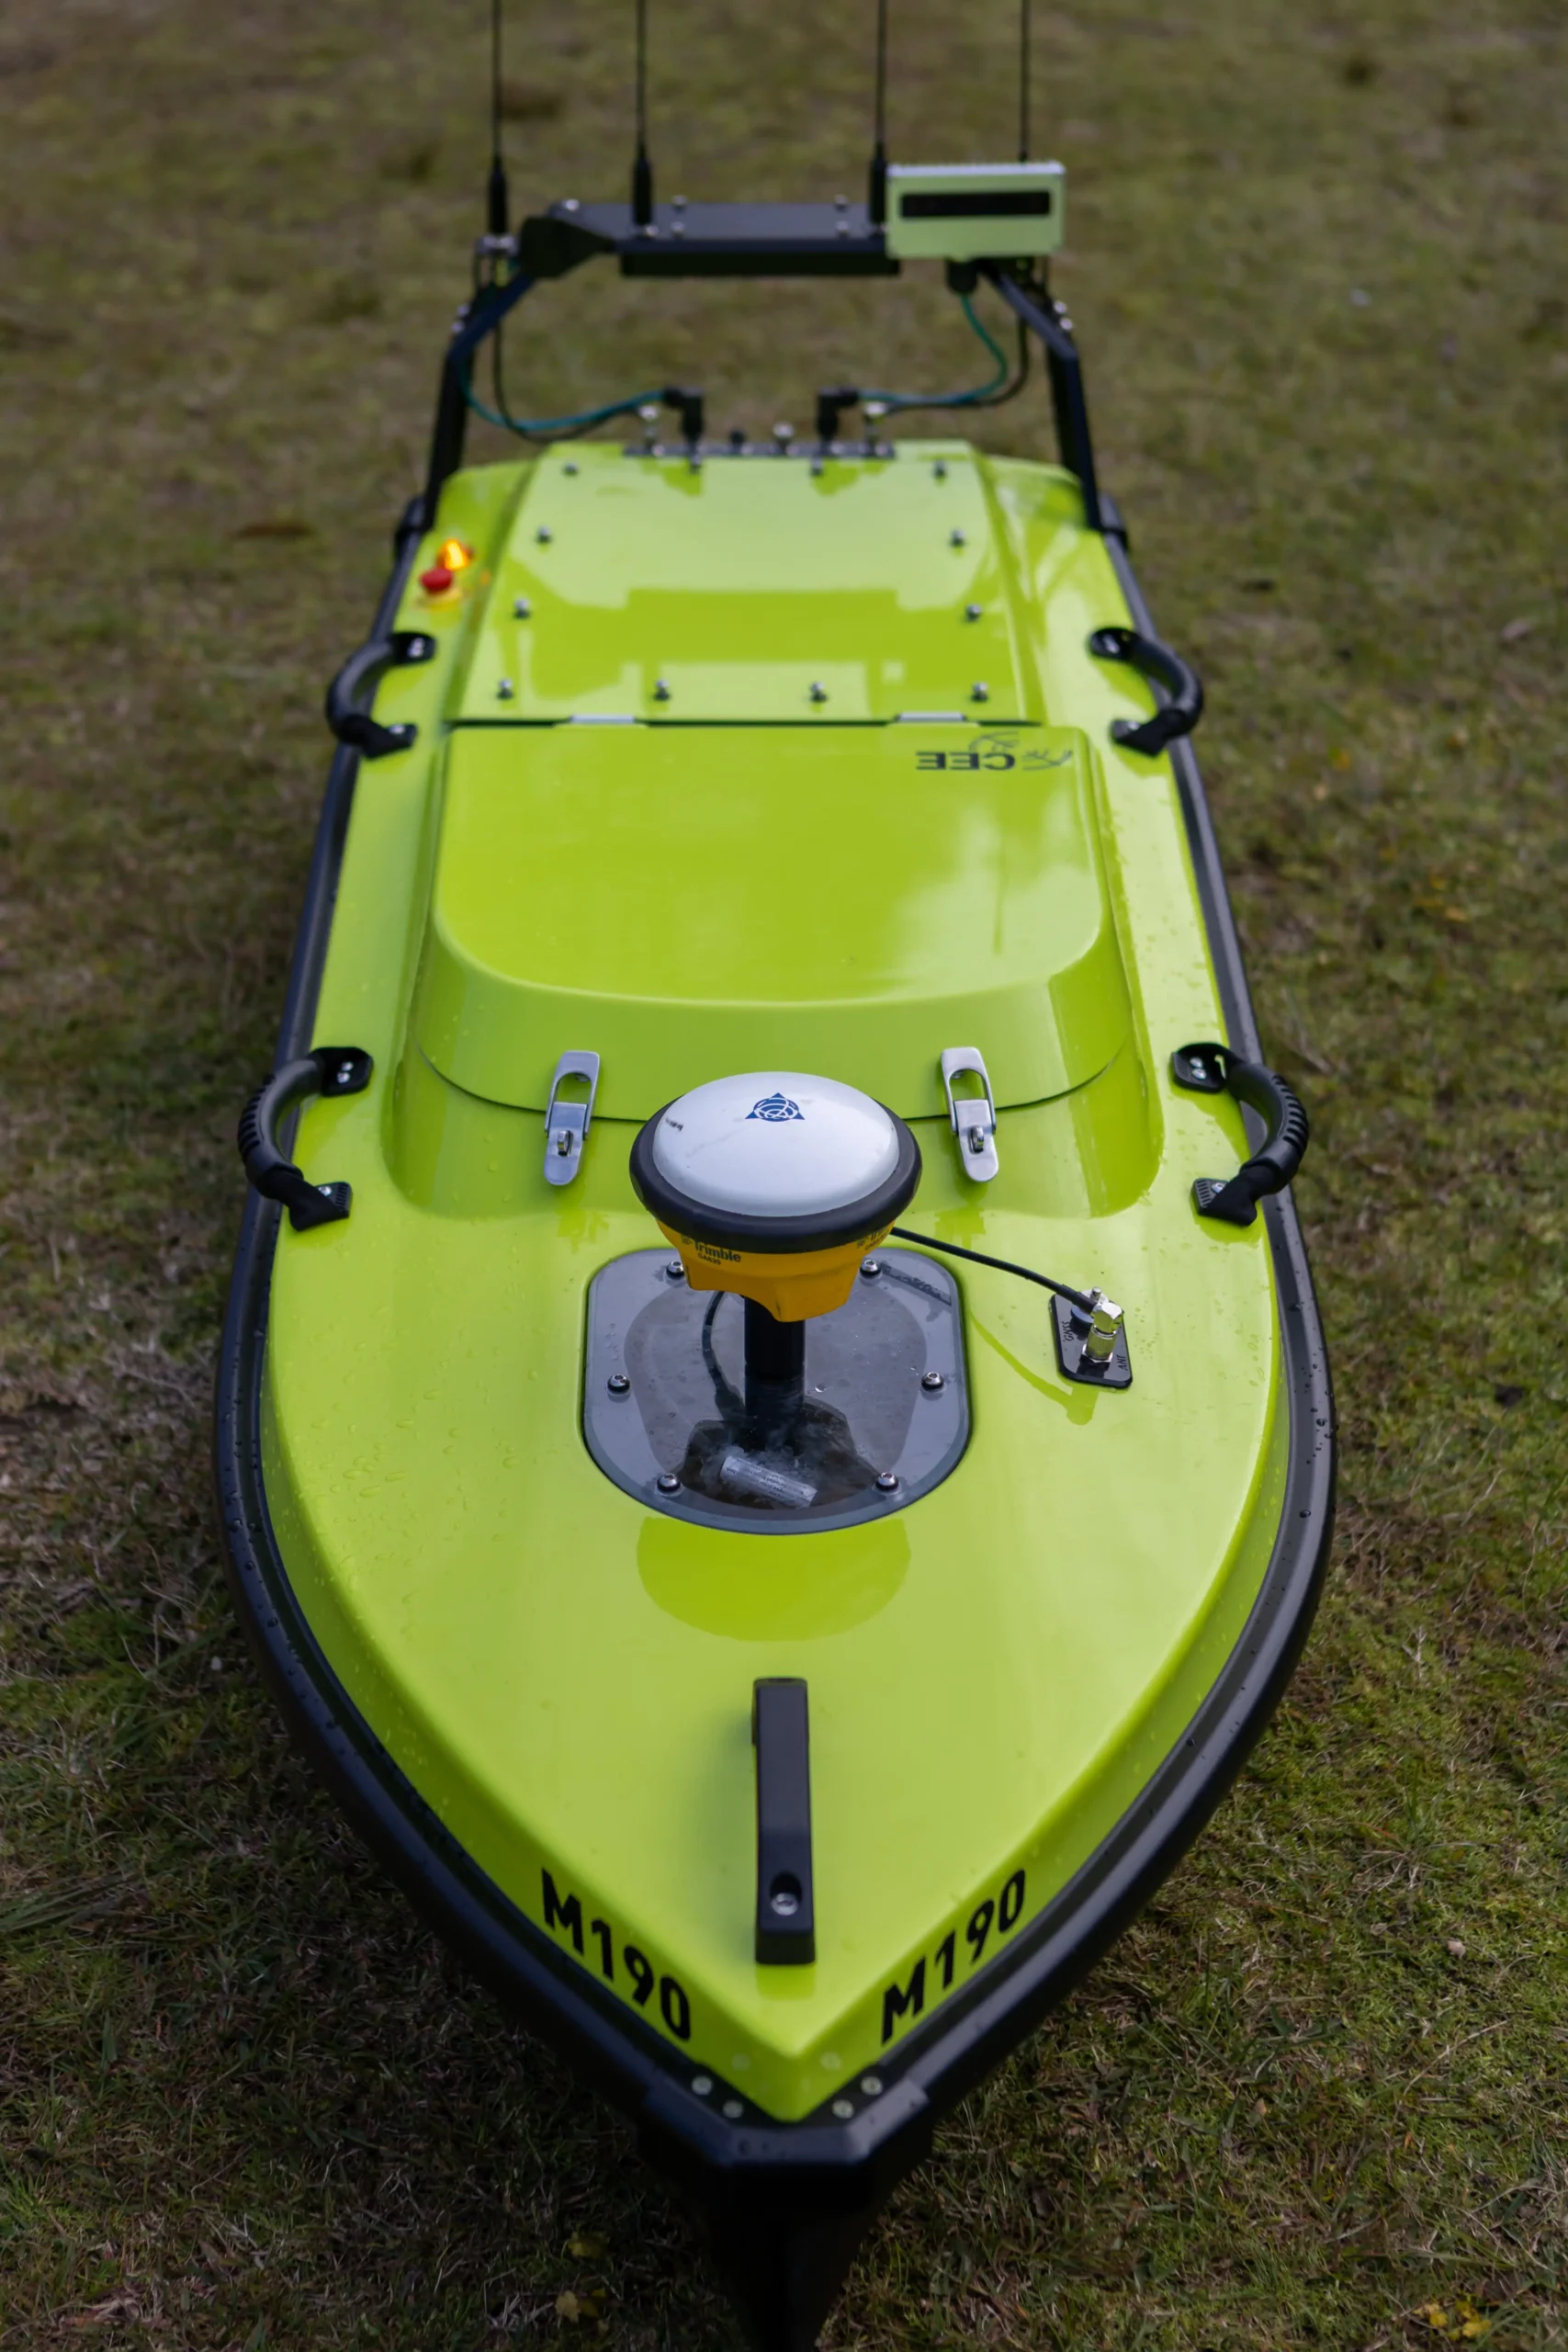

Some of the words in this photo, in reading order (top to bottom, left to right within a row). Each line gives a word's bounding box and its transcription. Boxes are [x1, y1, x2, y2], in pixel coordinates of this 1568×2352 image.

[916, 752, 1015, 770] CEE
[694, 1240, 741, 1262] Trimble
[1116, 1355, 1128, 1371] ANT
[542, 1867, 691, 2042] M190
[881, 1869, 1025, 2047] M190
